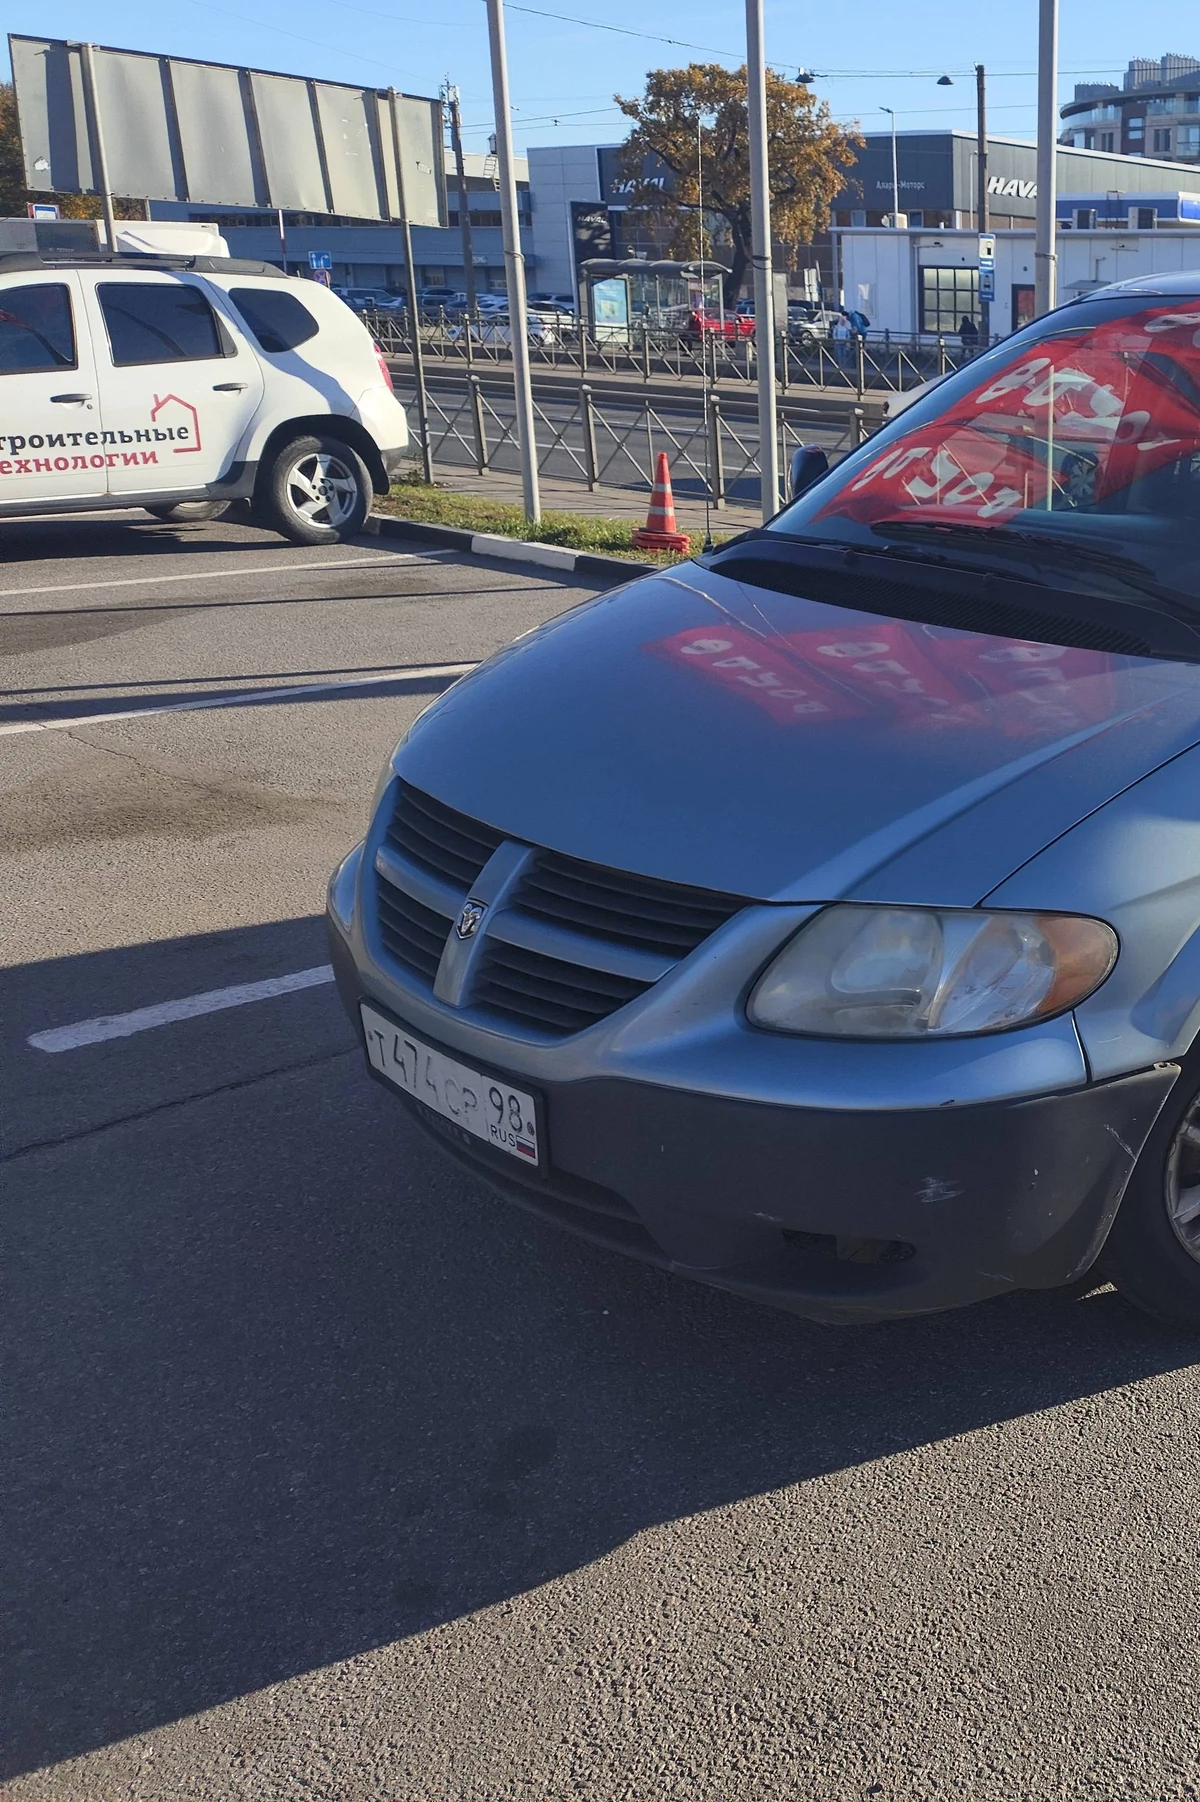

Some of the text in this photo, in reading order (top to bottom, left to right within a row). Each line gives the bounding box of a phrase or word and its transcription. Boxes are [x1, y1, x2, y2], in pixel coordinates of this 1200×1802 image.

[876, 180, 924, 190] Алар-Моторс
[489, 1087, 523, 1133] 98
[490, 1125, 516, 1147] RUS
